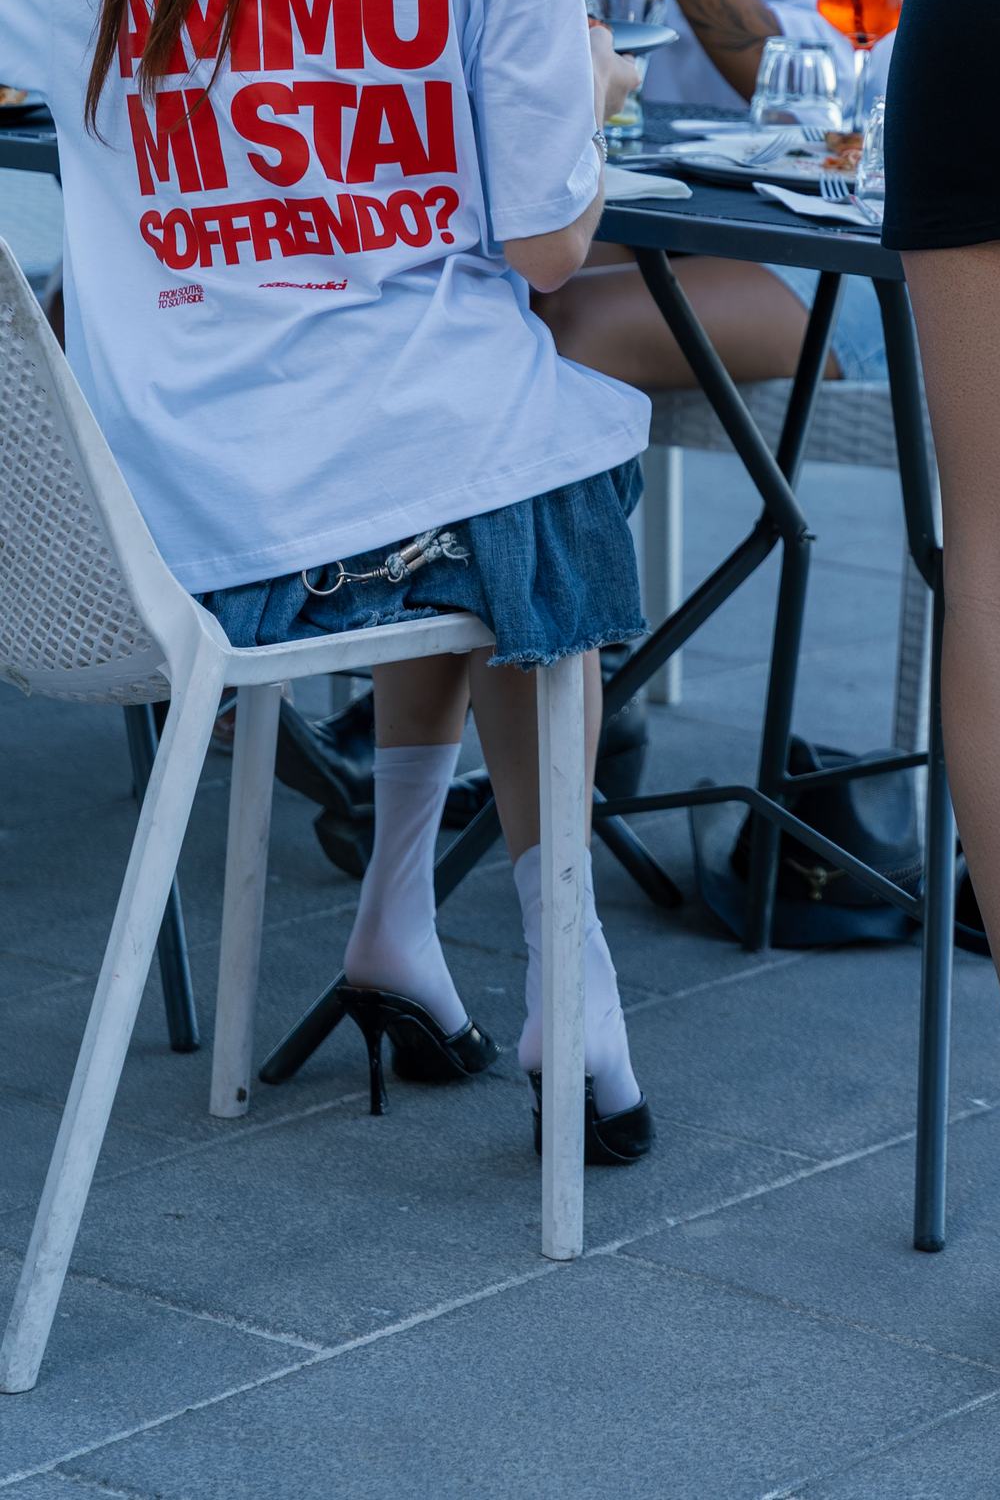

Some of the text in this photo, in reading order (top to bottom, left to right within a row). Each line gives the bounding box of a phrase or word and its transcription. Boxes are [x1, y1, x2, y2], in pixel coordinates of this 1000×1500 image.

[127, 80, 458, 197] MI STAI
[140, 186, 460, 270] SOFFRENDO?
[158, 289, 178, 300] FROM
[158, 300, 168, 309] TO
